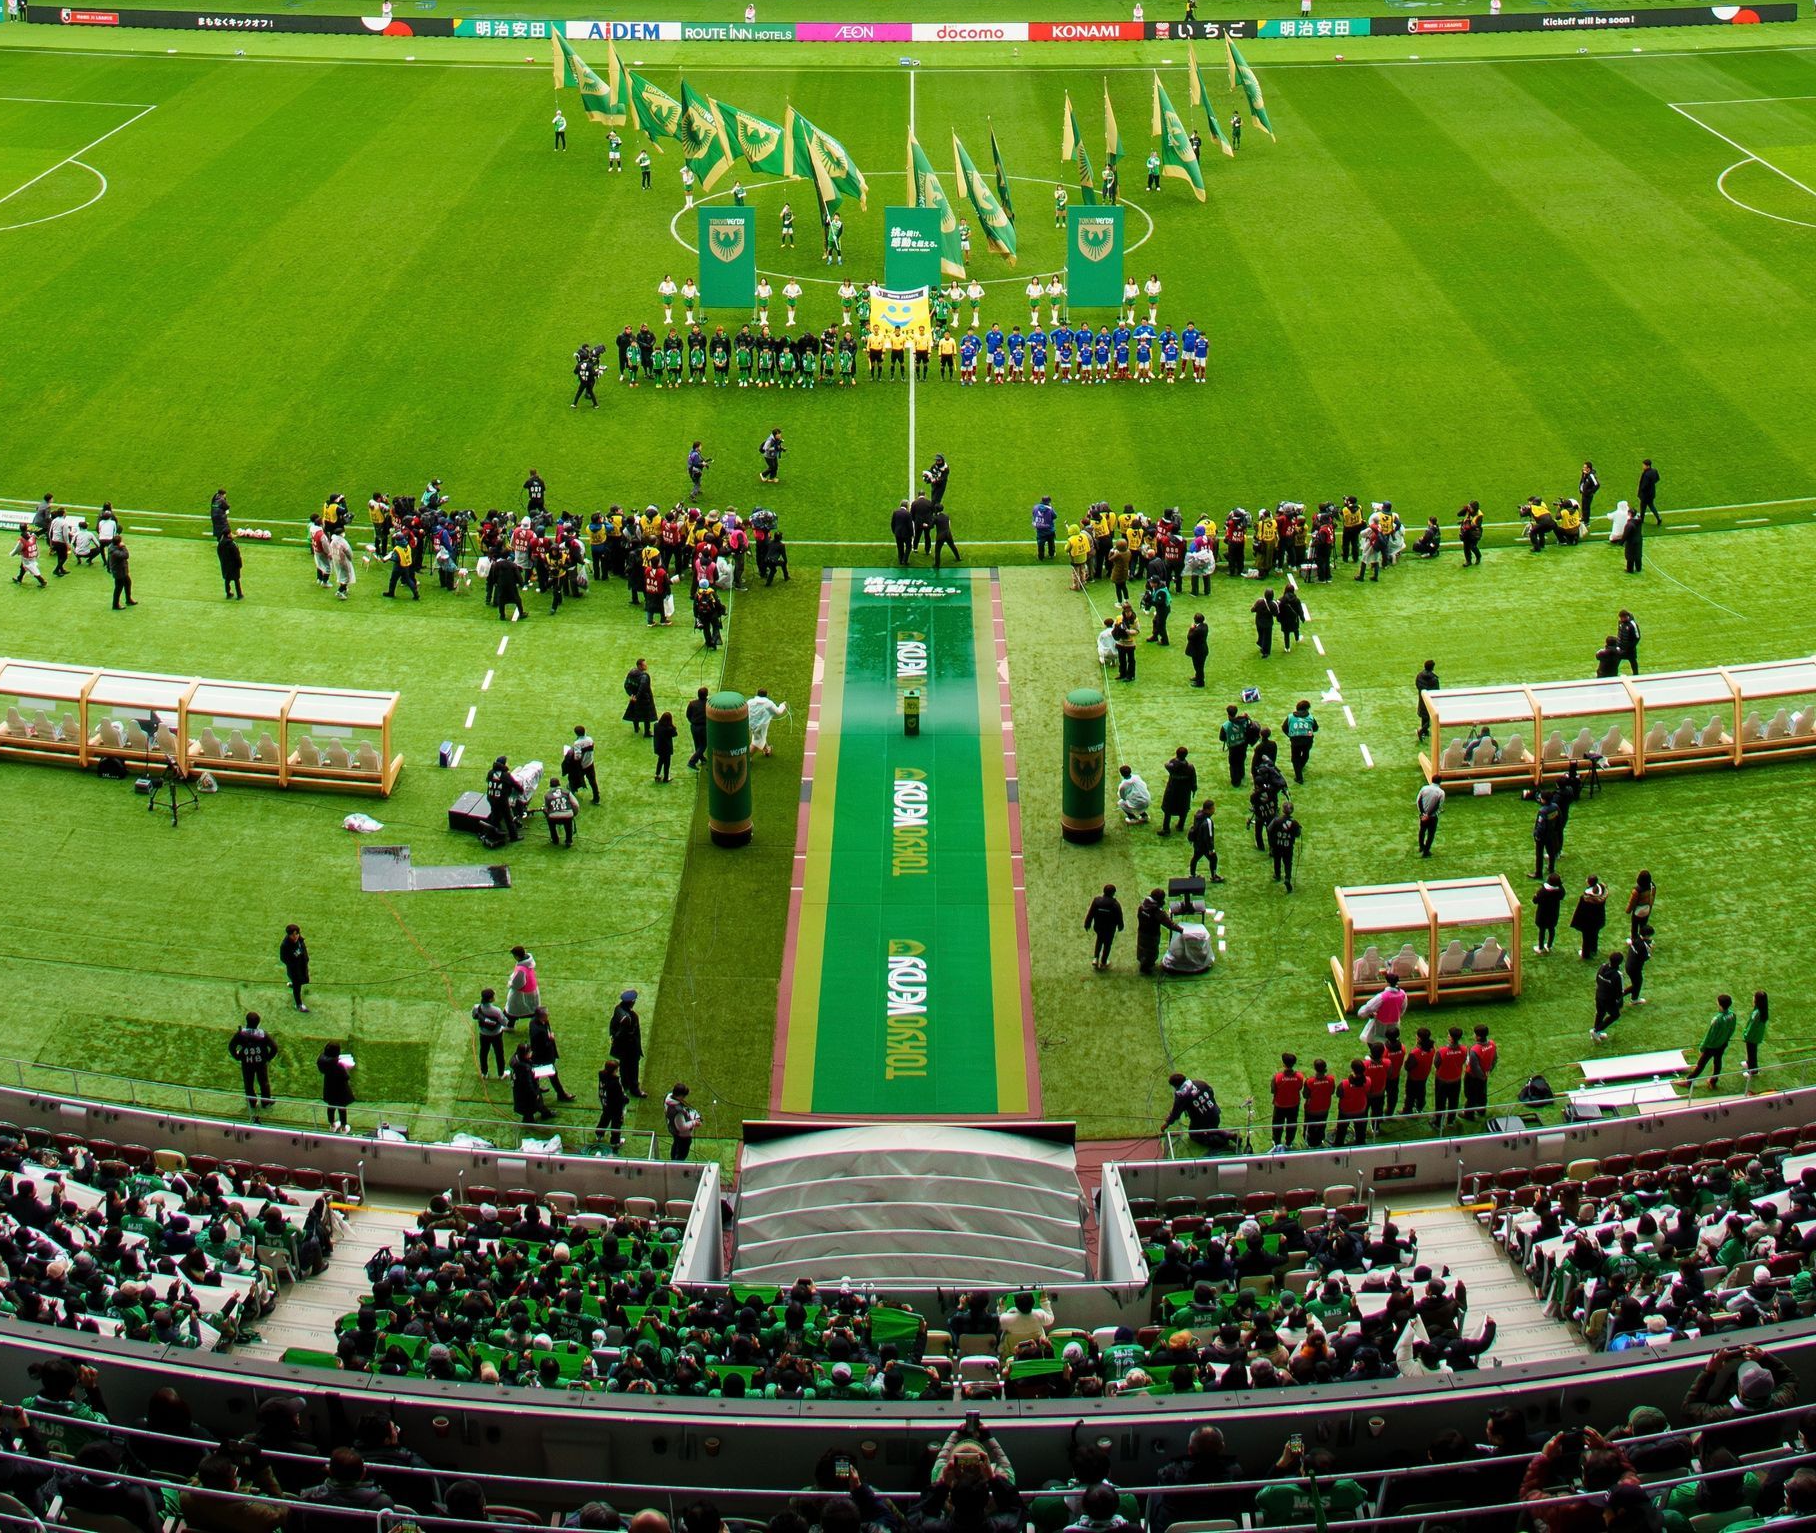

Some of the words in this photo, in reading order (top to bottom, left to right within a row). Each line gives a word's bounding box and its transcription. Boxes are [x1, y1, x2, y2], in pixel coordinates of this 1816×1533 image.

[1280, 20, 1350, 36] 明治安田
[1542, 16, 1575, 27] Kickoff
[1577, 15, 1594, 26] will
[1595, 15, 1607, 26] be
[475, 21, 546, 38] 明治安田
[685, 27, 727, 39] ROUTE
[755, 31, 792, 40] HOTELS
[936, 25, 1004, 39] docomo
[1052, 25, 1120, 38] KONAMI
[1177, 22, 1245, 38] いちご
[893, 779, 929, 827] VERDY
[892, 826, 929, 877] TOKYO
[887, 956, 928, 1016] VERDY
[886, 1016, 928, 1080] TOKYO
[1324, 1307, 1342, 1318] MJS
[1114, 1348, 1134, 1358] MJS
[34, 1421, 65, 1438] MJS
